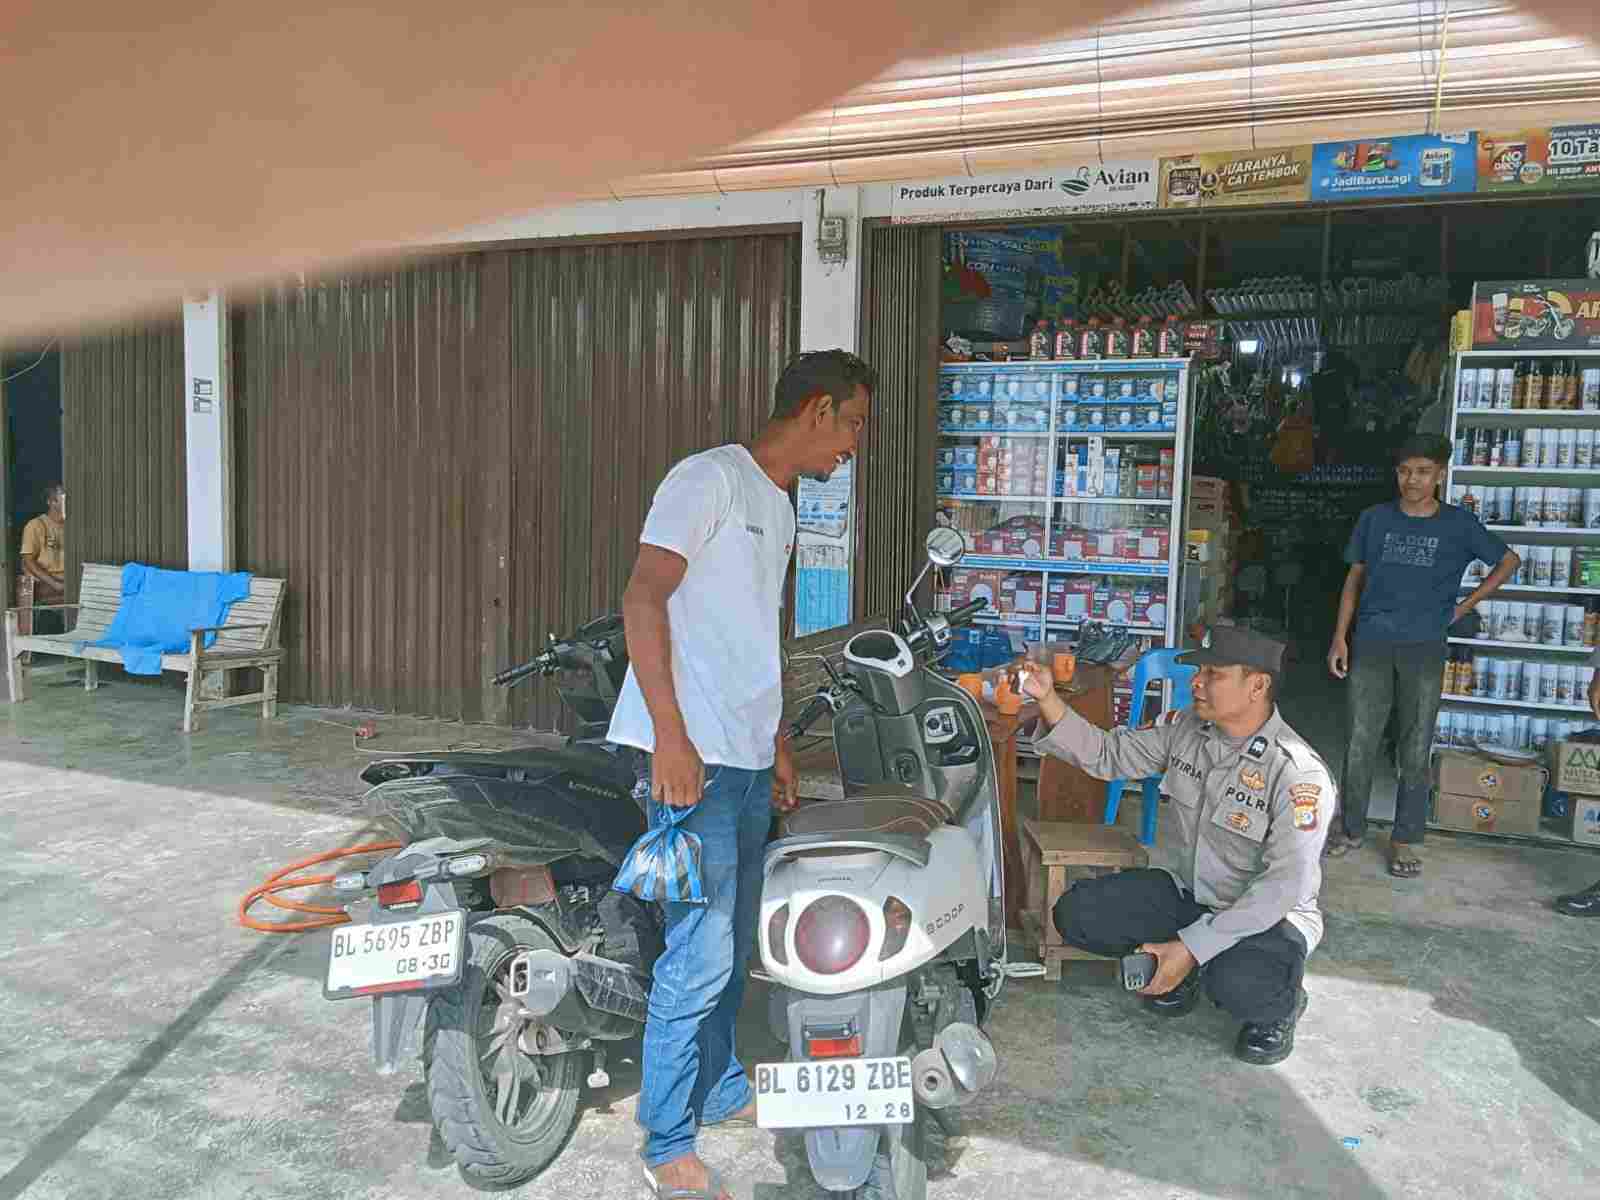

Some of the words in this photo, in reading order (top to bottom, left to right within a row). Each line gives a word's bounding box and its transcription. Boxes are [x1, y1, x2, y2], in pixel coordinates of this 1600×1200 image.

[1220, 153, 1287, 176] JUARANYA
[1227, 174, 1249, 187] CAT
[1250, 163, 1301, 185] TEMBOK
[900, 185, 945, 200] Produk
[949, 179, 1021, 198] Terpercaya
[1024, 176, 1053, 193] Dari
[1094, 168, 1150, 186] Avian
[334, 934, 356, 958] BL
[363, 926, 410, 953] 5695
[419, 919, 455, 946] ZBP
[758, 1067, 786, 1094] BL
[797, 1063, 856, 1093] 6129
[865, 1060, 911, 1091] ZBE
[845, 1103, 867, 1121] 12
